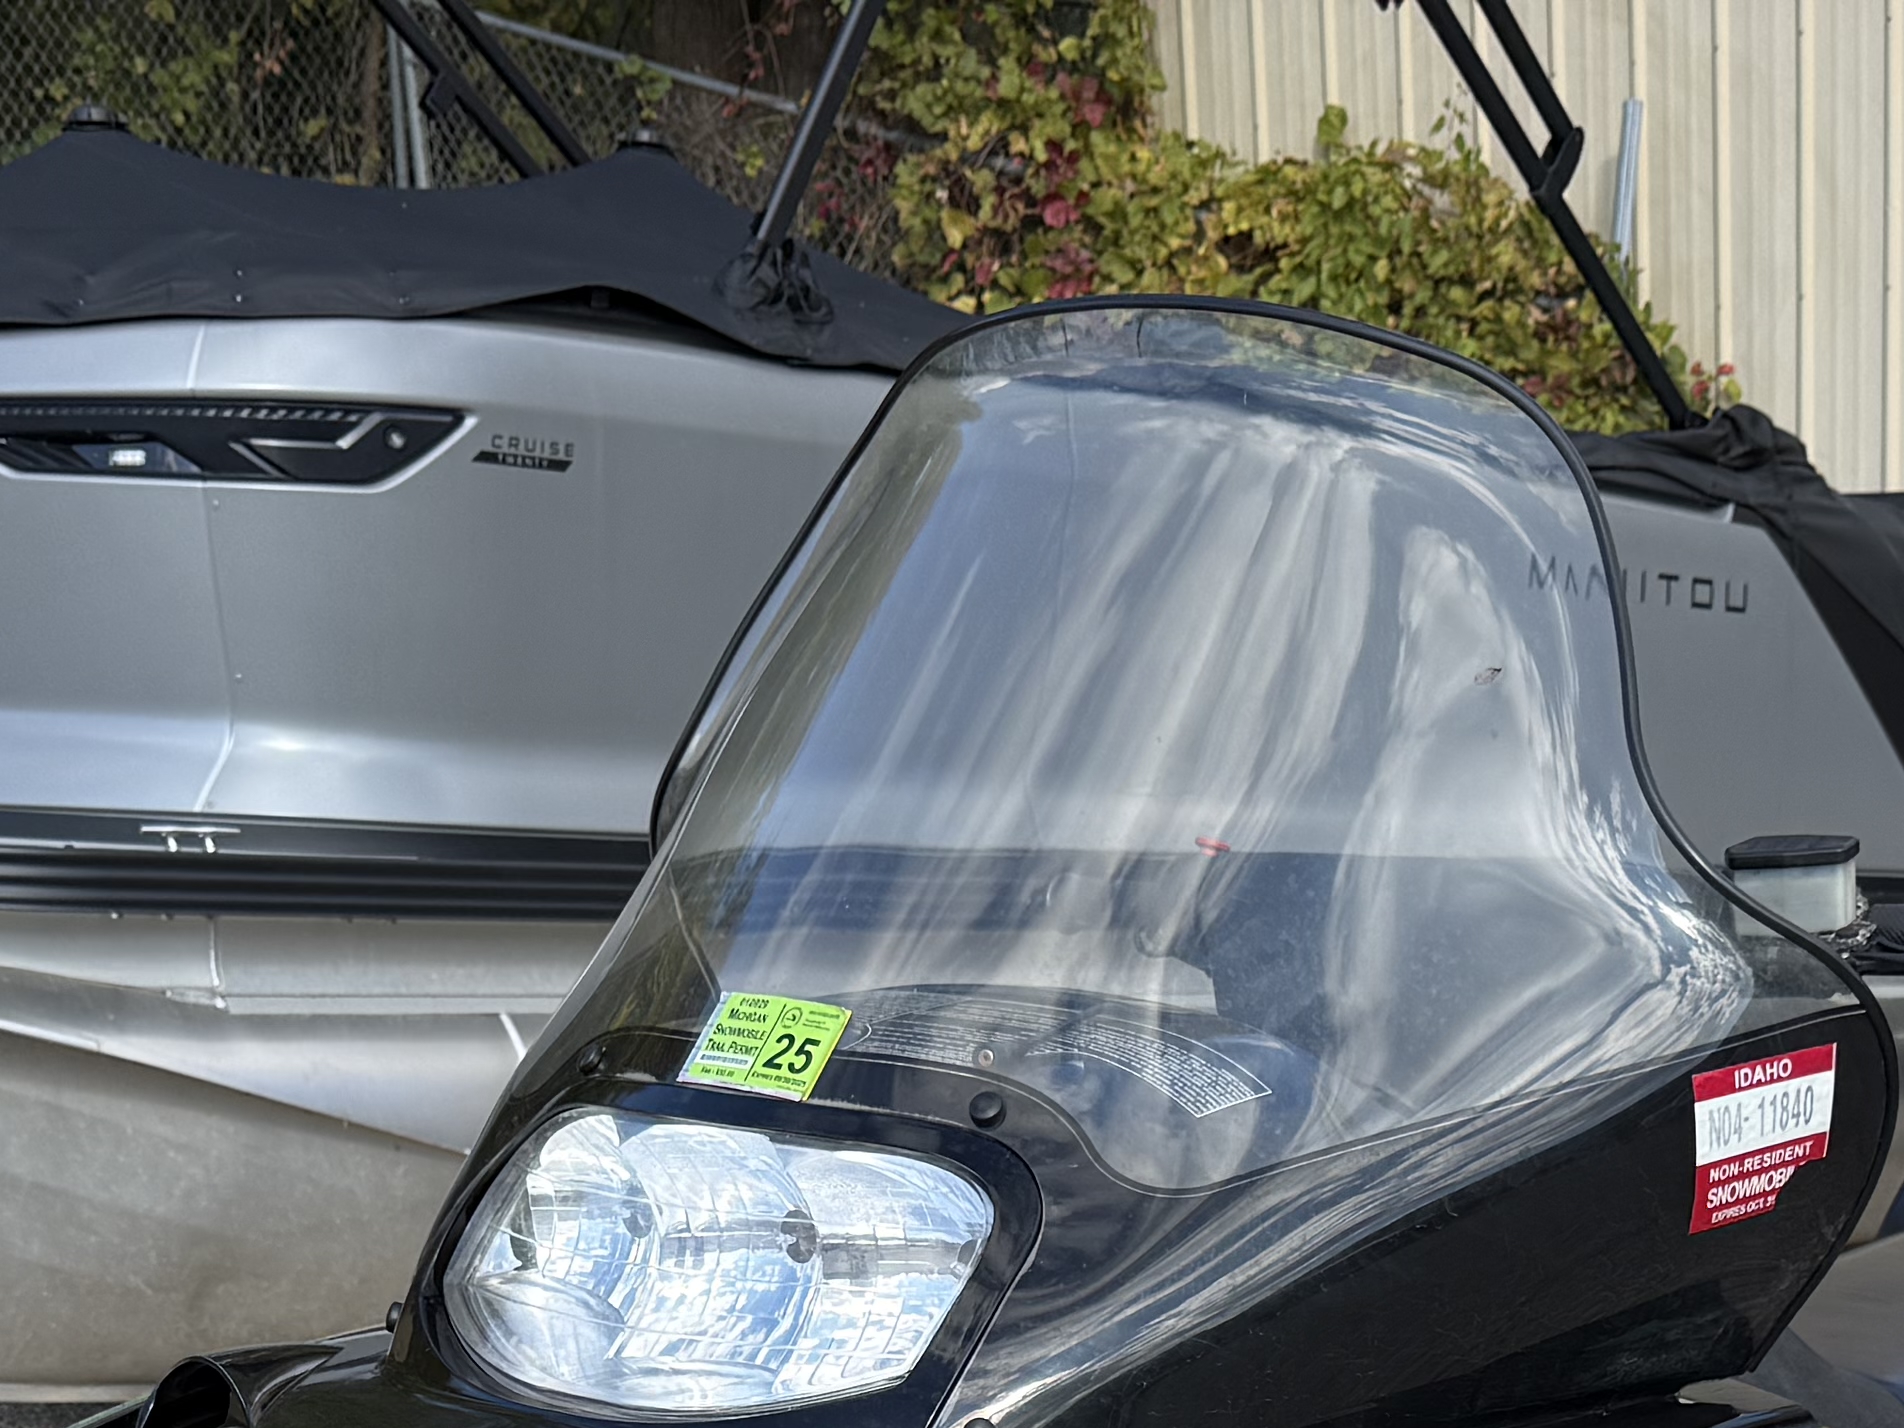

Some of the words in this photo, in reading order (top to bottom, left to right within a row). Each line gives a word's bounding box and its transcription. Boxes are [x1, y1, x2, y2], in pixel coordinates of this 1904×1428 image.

[491, 434, 575, 458] CRUISE
[1527, 553, 1749, 613] MANITOU
[762, 1033, 822, 1074] 25
[1734, 1058, 1792, 1089] IDAHO
[1709, 1140, 1814, 1183] NON-RESIDENT
